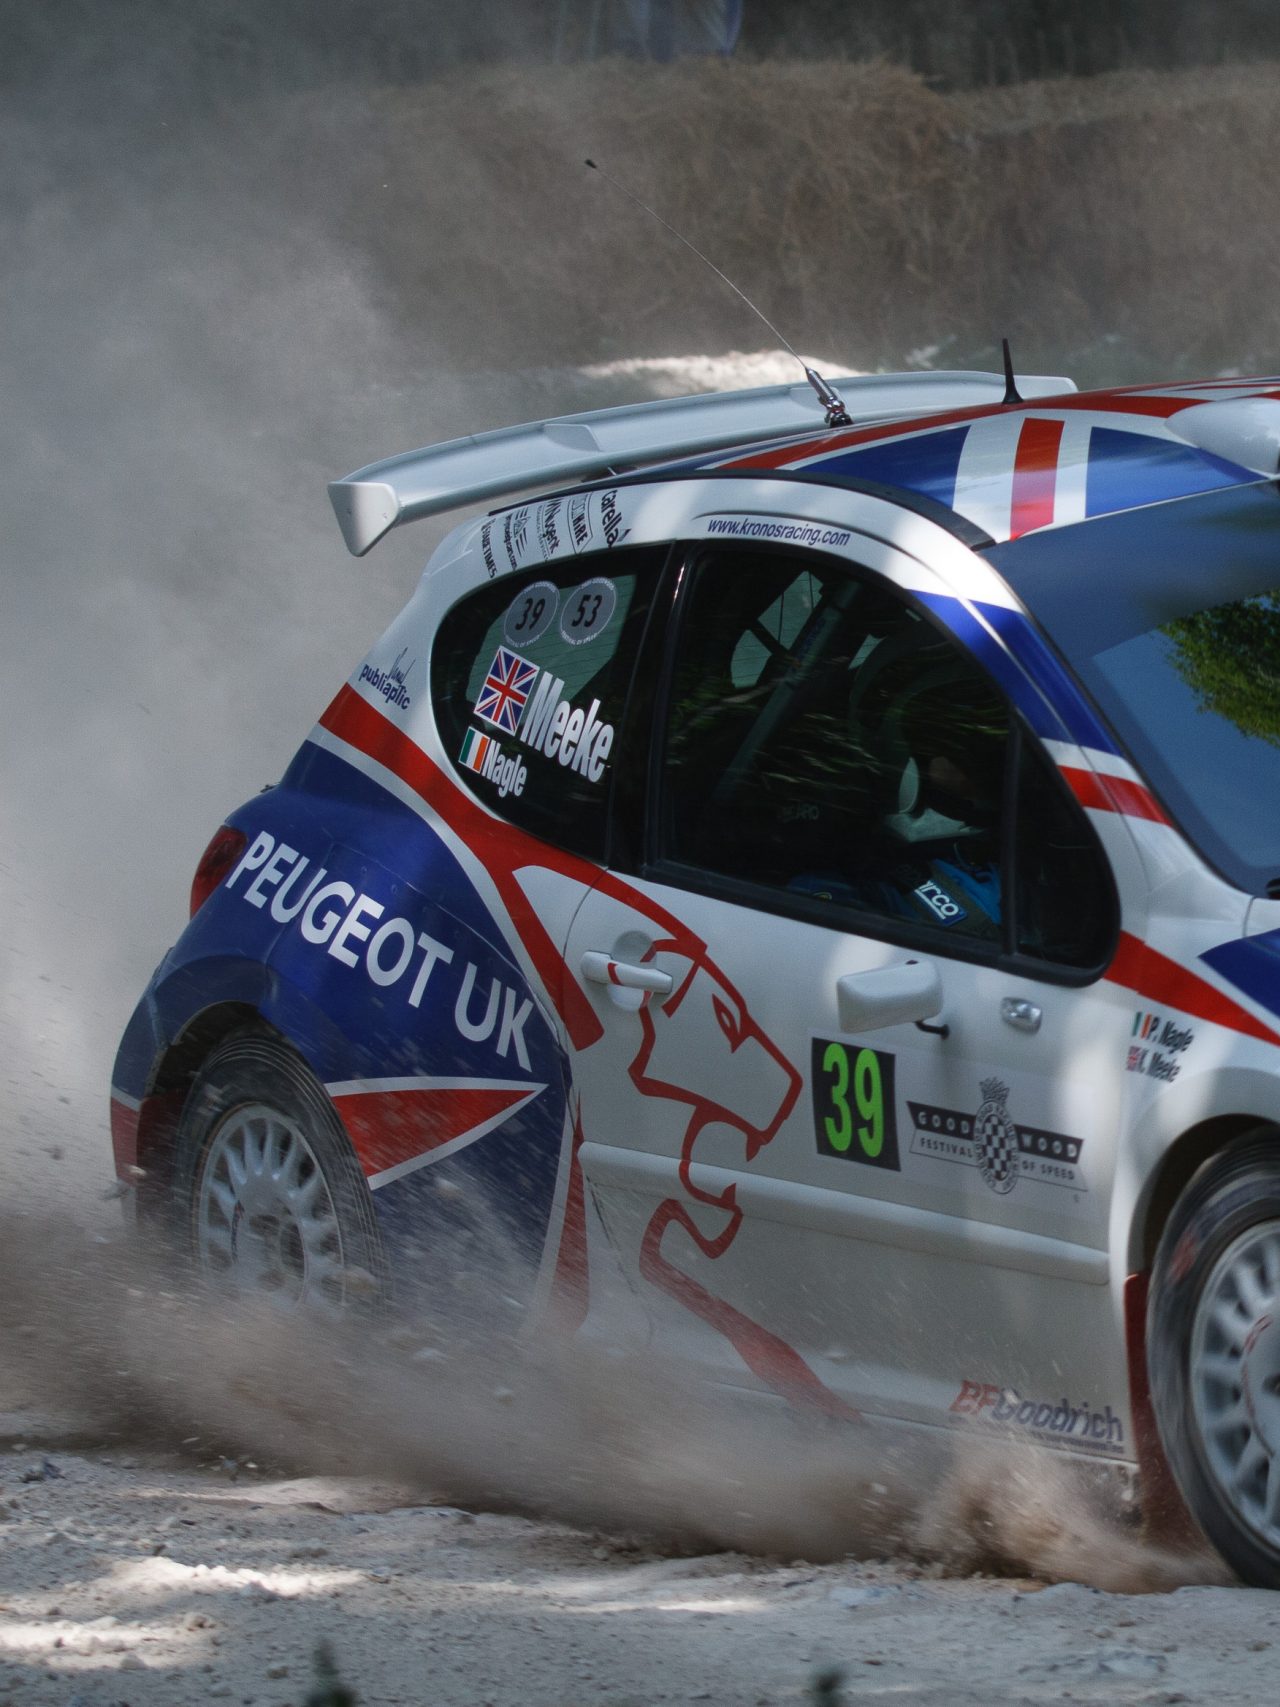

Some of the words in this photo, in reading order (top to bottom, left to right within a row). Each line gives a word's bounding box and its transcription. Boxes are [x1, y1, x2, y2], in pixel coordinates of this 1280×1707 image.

[707, 518, 851, 546] www.kronosracing.com
[515, 598, 546, 630] 39
[571, 594, 603, 628] 53
[520, 672, 614, 783] Meeke
[482, 739, 527, 797] Nagle
[225, 830, 454, 1009] PEUGEOT
[454, 963, 534, 1073] UK
[1158, 1020, 1194, 1054] Nagle
[1147, 1052, 1181, 1083] Meeke
[821, 1042, 885, 1157] 39
[917, 1111, 970, 1134] GOOD
[1021, 1134, 1078, 1158] WOOD
[919, 1137, 974, 1158] FESTIVAL
[1021, 1160, 1035, 1171] OF
[1040, 1162, 1076, 1180] SPEED
[949, 1379, 1124, 1442] BFGoodrich
